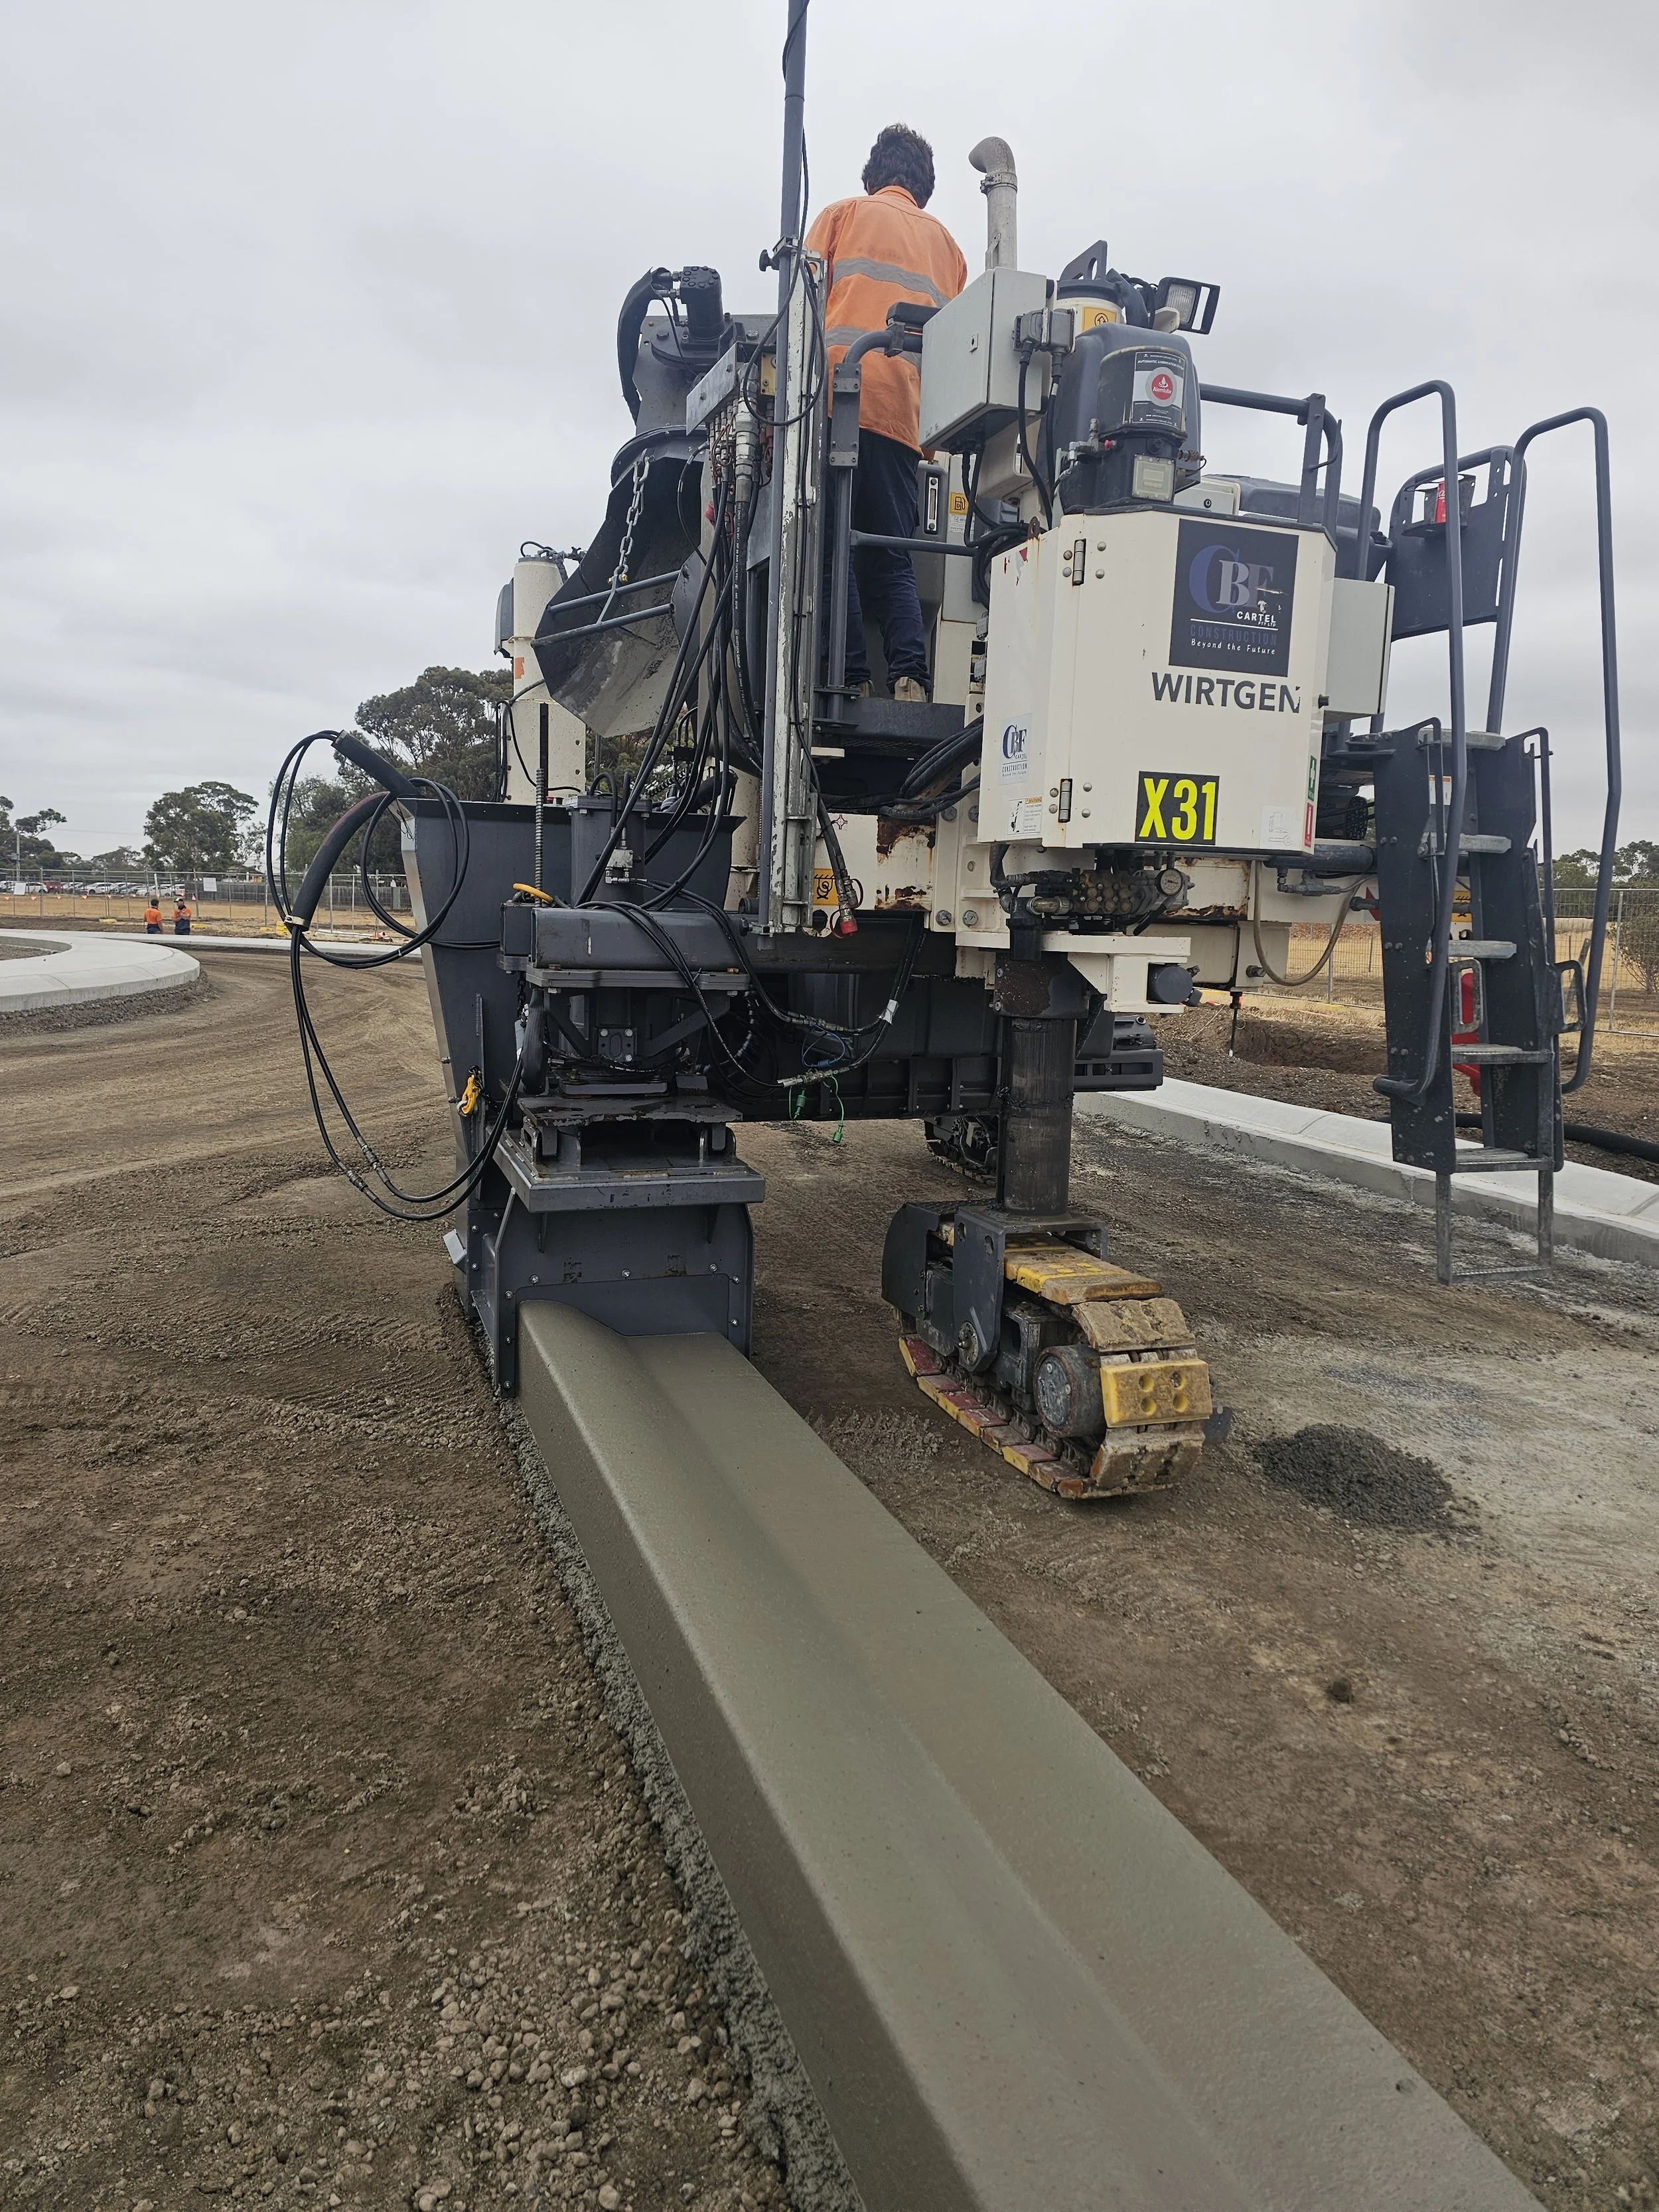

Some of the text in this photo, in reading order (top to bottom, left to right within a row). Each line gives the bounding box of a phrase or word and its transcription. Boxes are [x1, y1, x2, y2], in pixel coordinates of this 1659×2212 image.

[1236, 611, 1276, 623] CARTEL
[1190, 625, 1277, 645] CONSTRUCTION
[1191, 638, 1222, 648] Beyond
[1247, 644, 1275, 654] Future
[1151, 672, 1301, 713] WIRTGEN
[1003, 763, 1027, 773] CONSTRUCTION
[1139, 777, 1216, 841] X31
